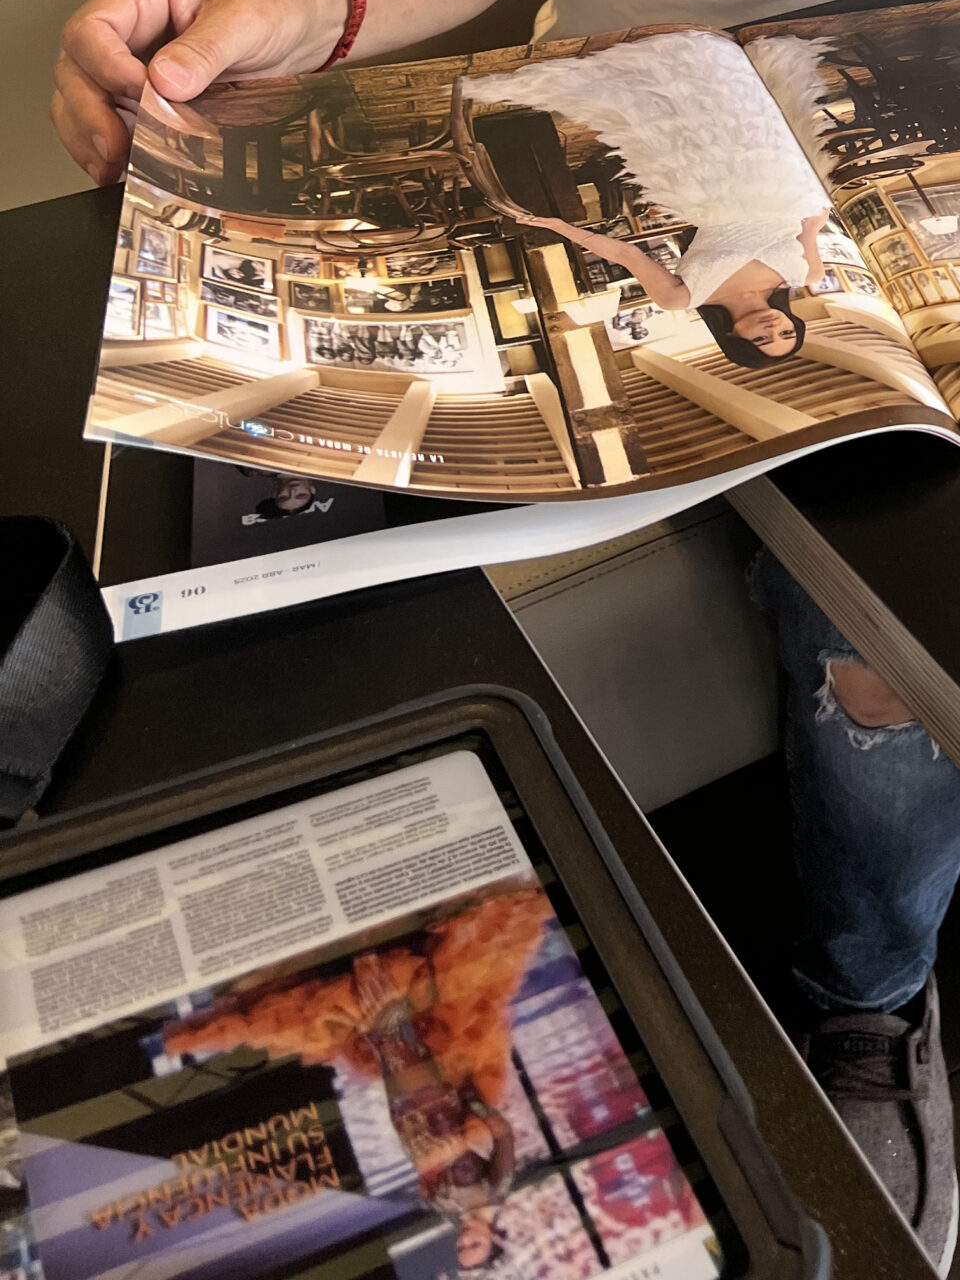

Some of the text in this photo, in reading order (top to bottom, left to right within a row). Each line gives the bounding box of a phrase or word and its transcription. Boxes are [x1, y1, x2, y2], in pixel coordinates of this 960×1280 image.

[299, 434, 312, 443] DE
[318, 438, 351, 450] MODA
[357, 445, 370, 454] DE
[429, 454, 443, 463] LA
[170, 1101, 319, 1169] MUNDIAL
[286, 1125, 326, 1154] SU
[242, 1169, 340, 1221] MODA
